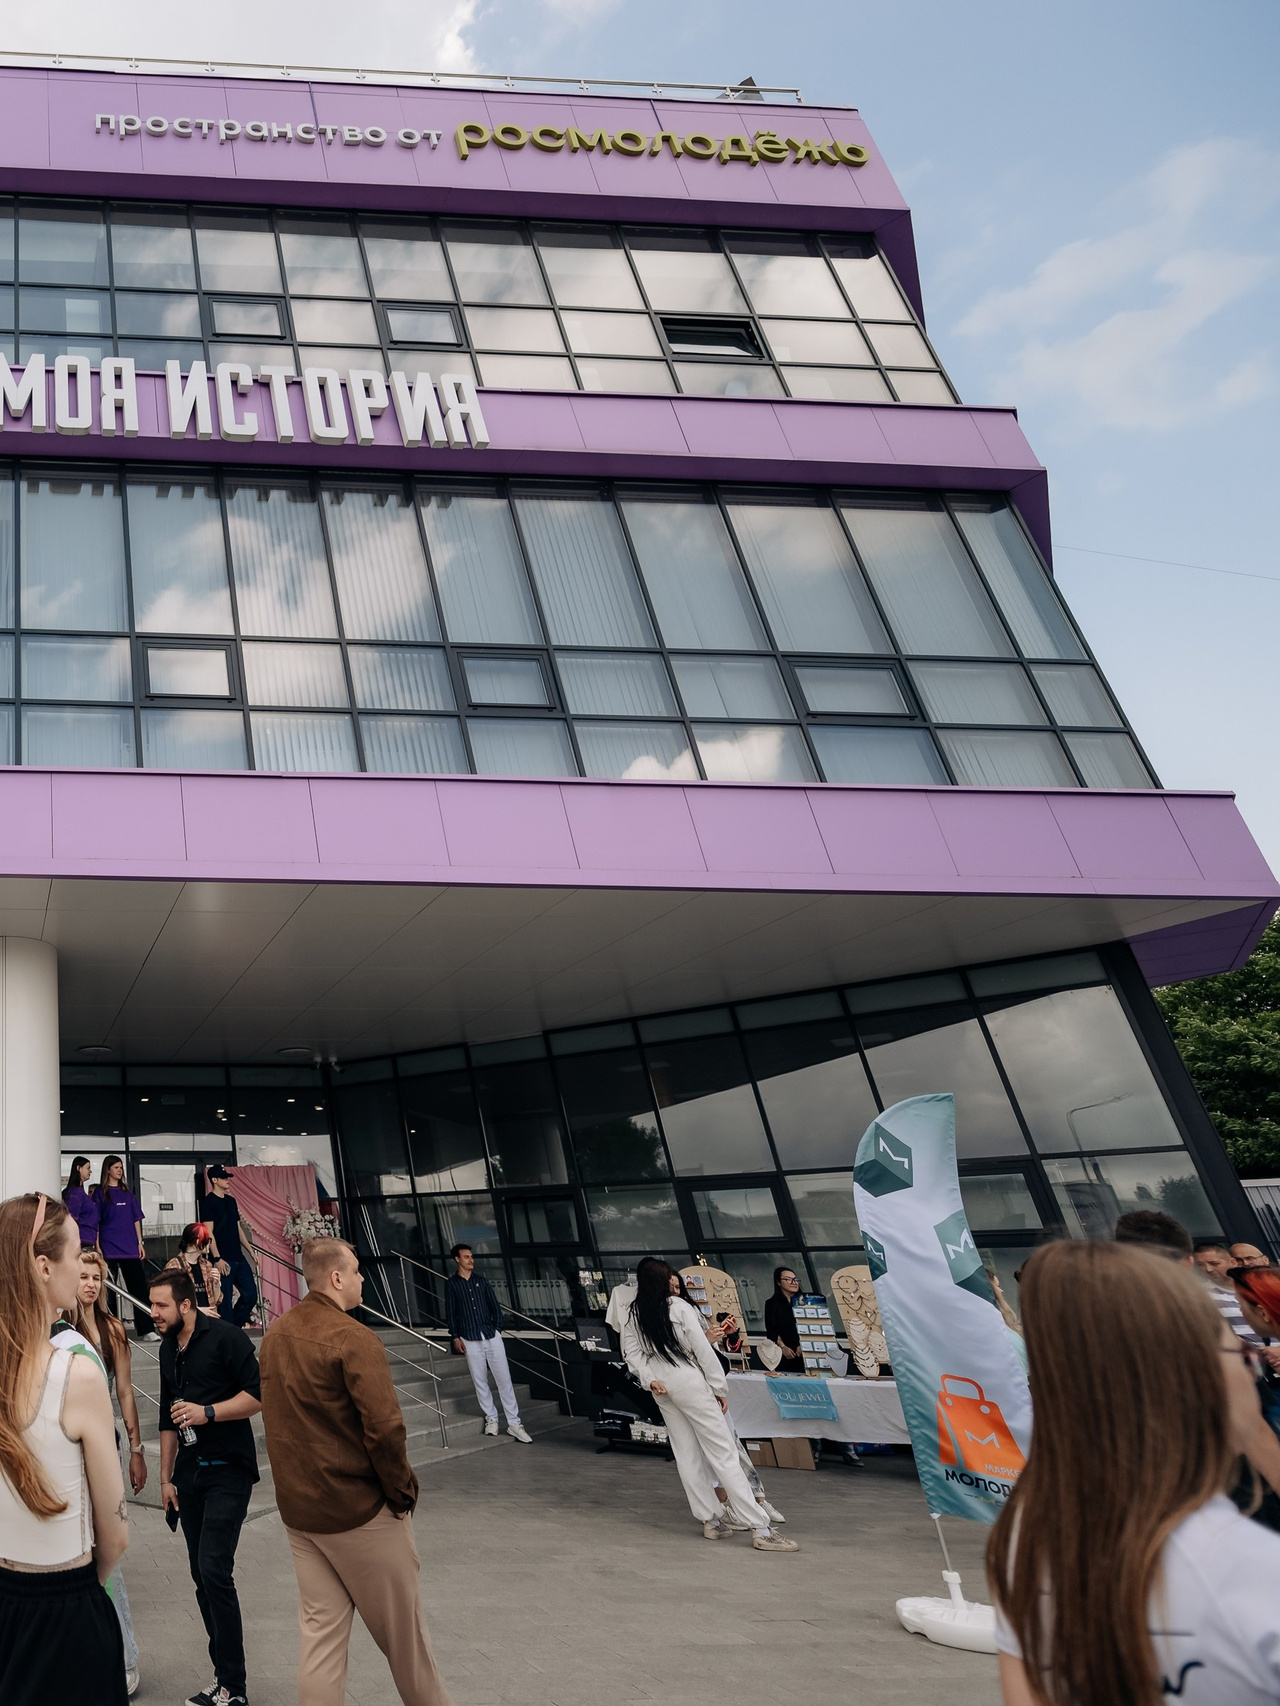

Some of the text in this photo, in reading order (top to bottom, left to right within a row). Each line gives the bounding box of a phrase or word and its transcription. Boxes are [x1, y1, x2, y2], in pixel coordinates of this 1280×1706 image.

[95, 113, 870, 167] пространство от росмолодёжь
[166, 359, 491, 451] ИСТОРИЯ
[772, 1392, 827, 1402] YOU JEWEL
[944, 1468, 1016, 1498] МОЛОД
[984, 1463, 1022, 1477] МАРКЕ
